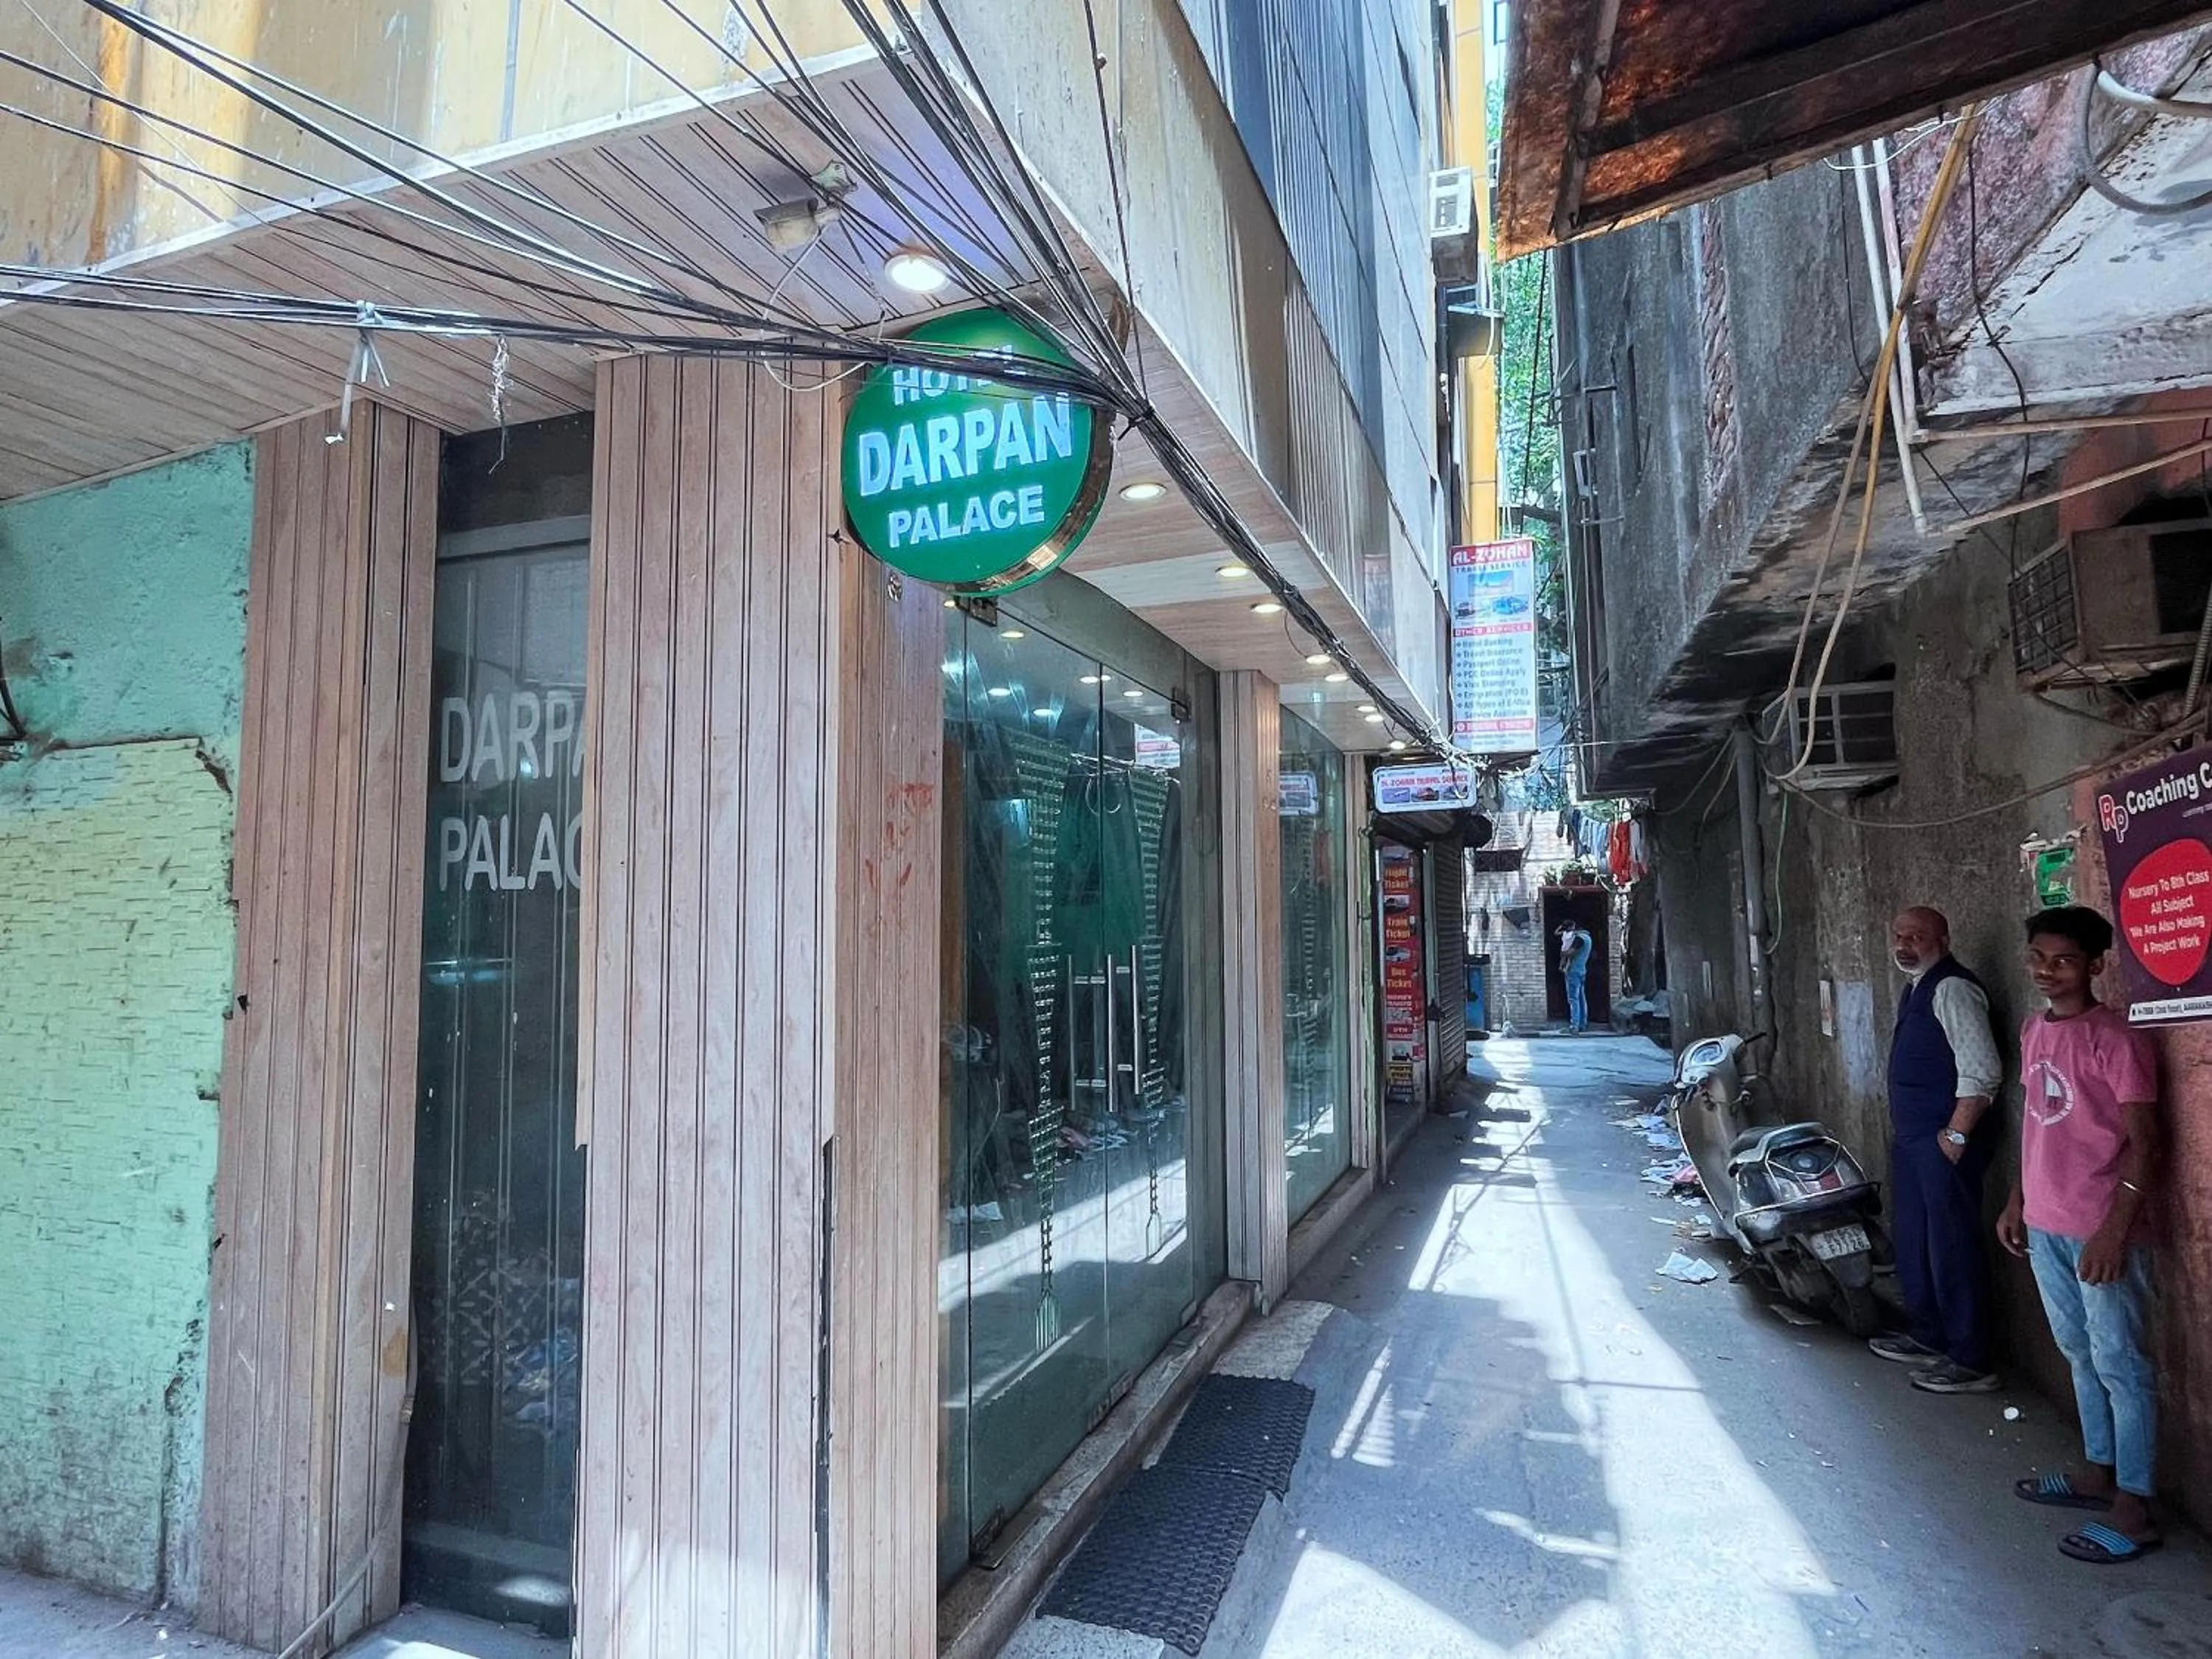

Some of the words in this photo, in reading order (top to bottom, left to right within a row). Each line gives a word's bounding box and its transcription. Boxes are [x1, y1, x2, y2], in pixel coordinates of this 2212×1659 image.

[858, 392, 1073, 496] DARPAN
[888, 484, 1045, 548] PALACE
[1453, 545, 1527, 566] AL-ZOHAN
[2126, 773, 2199, 815] Coaching
[2186, 870, 2210, 886] Class
[2163, 894, 2194, 912] Subject
[2158, 919, 2176, 933] Also
